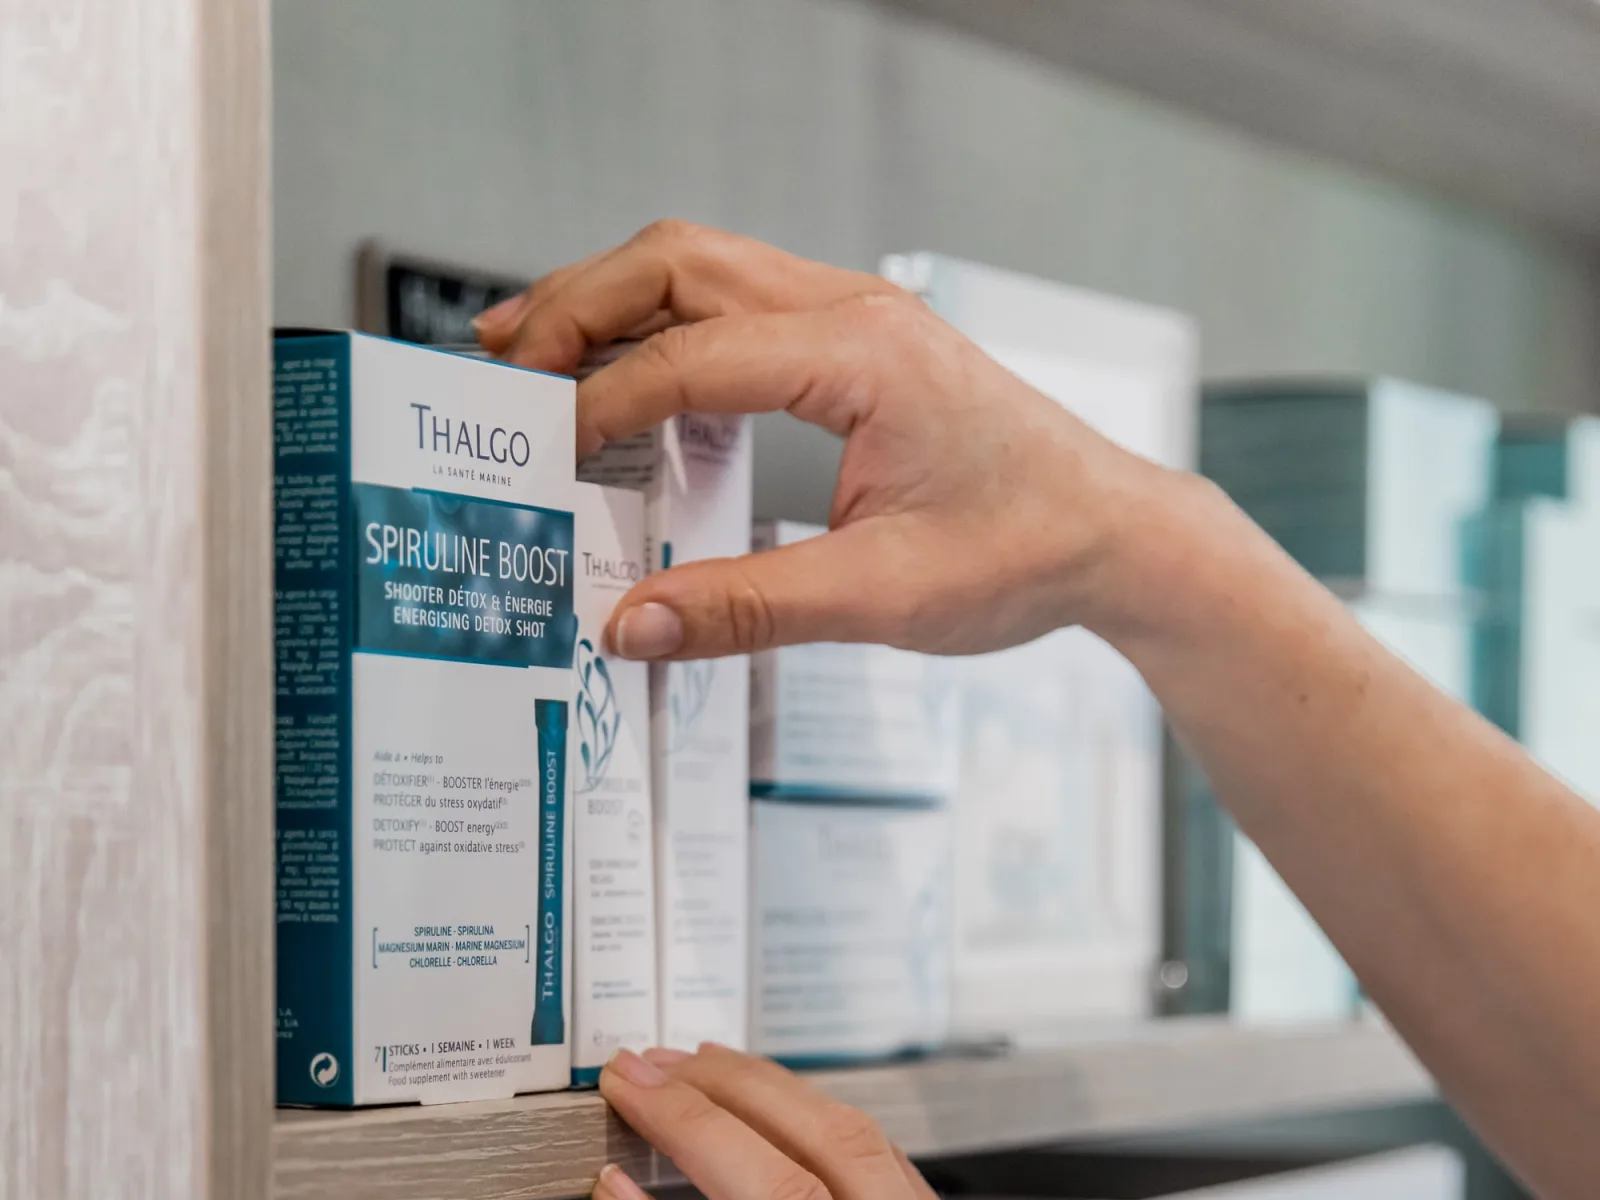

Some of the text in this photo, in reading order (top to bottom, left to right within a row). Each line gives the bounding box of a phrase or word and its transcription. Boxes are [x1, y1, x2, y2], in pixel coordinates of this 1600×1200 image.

[410, 402, 530, 467] THALGO
[432, 464, 512, 487] LA SANTÉ MARINE
[365, 522, 491, 578] SPIRULINE
[499, 541, 569, 587] BOOST
[384, 580, 553, 617] SHOOTER DÉTOX & ÉNERGIE
[393, 605, 546, 639] ENERGISING DETOX SHOT
[410, 752, 434, 765] Helps
[435, 754, 444, 764] to
[443, 776, 482, 790] BOOSTER
[425, 795, 437, 808] du
[439, 796, 465, 809] stress
[435, 820, 464, 833] BOOST
[373, 838, 417, 852] PROTECT
[419, 840, 452, 856] against
[454, 840, 493, 854] oxidative
[542, 750, 557, 1002] THALGO SPIRULINE BOOST
[414, 926, 452, 937] SPIRULINE
[457, 925, 494, 936] SPIRULINA
[378, 942, 424, 953] MAGNESIUM
[425, 941, 450, 953] MARIN
[455, 940, 483, 951] MARINE
[483, 938, 525, 951] MAGNESIUM
[409, 957, 451, 968] CHLORELLE
[457, 955, 497, 967] CHLORELLA
[374, 1045, 381, 1063] 7
[389, 1043, 420, 1057] STICKS
[438, 1040, 475, 1053] SEMAINE
[493, 1037, 516, 1049] WEEK
[388, 1058, 435, 1073] Complément
[436, 1055, 475, 1069] alimentaire
[477, 1056, 493, 1066] avec
[388, 1067, 506, 1087] Food supplement with sweetener
